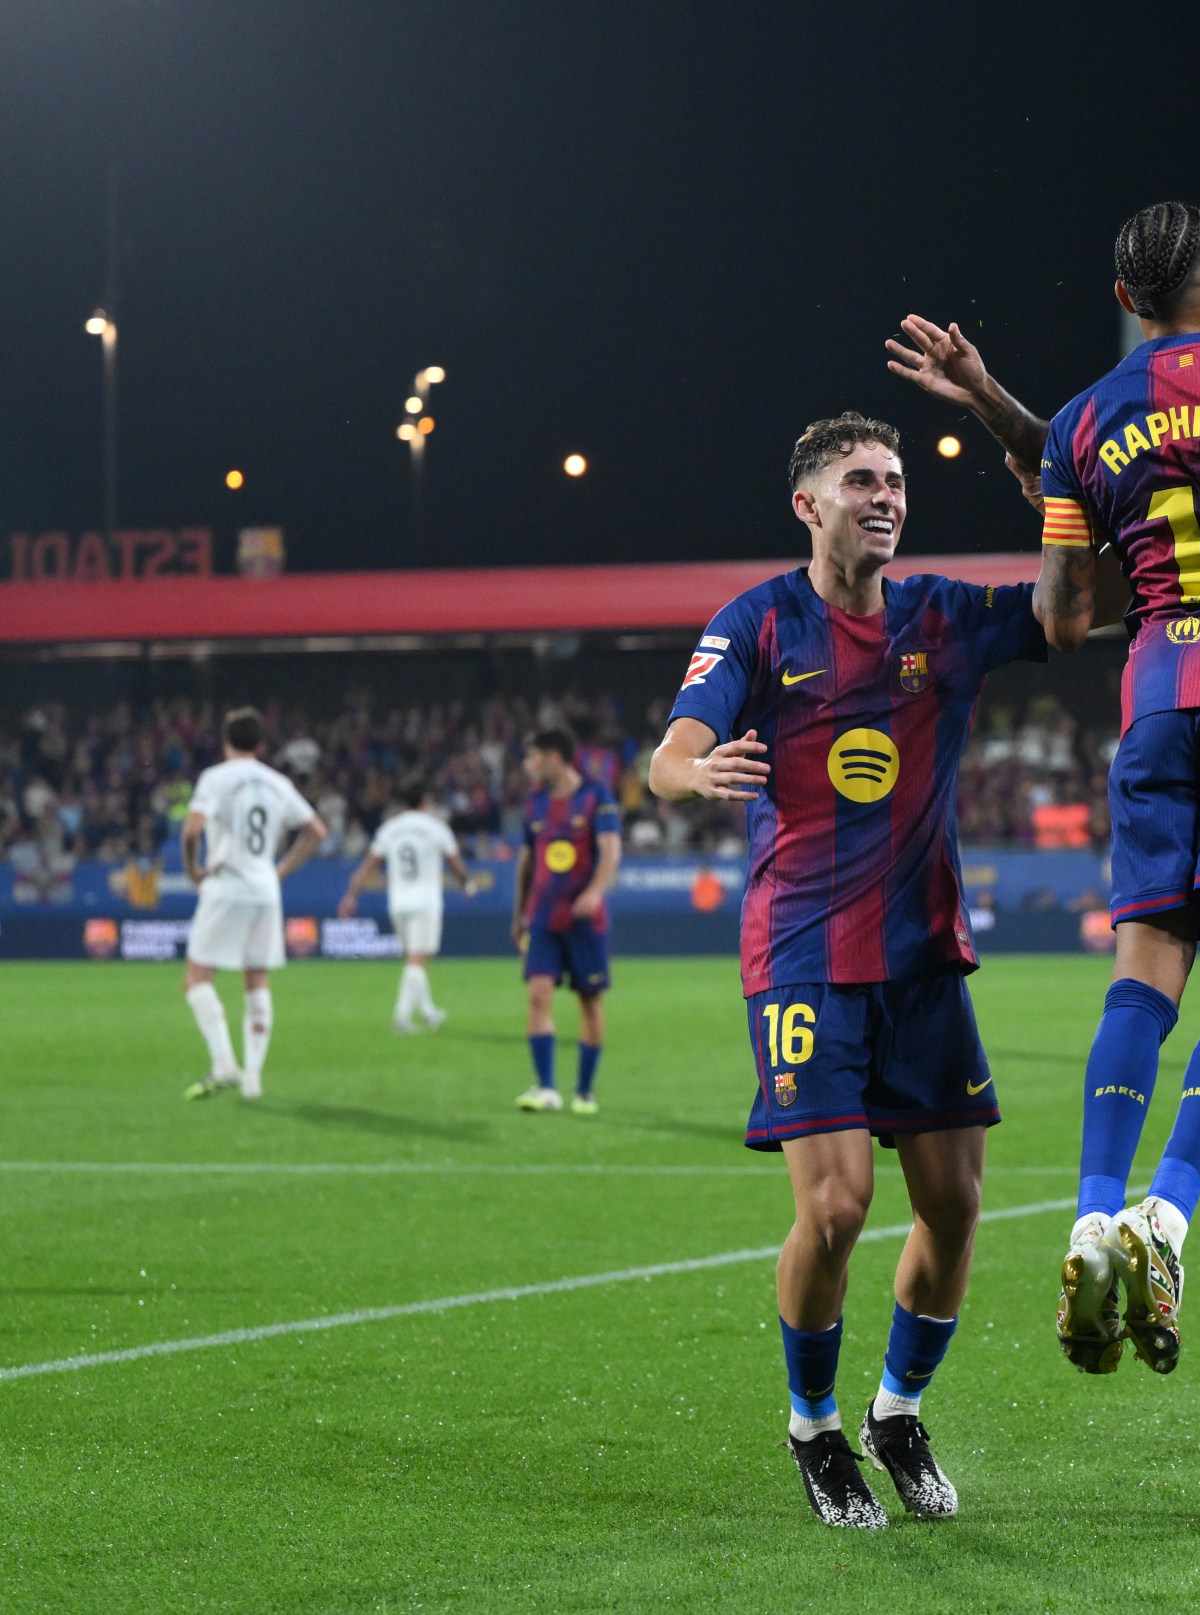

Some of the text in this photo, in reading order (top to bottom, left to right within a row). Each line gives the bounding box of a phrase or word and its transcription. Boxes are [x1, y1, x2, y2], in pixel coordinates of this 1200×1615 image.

[247, 804, 268, 857] 8
[398, 842, 420, 883] 9
[762, 1003, 816, 1068] 16
